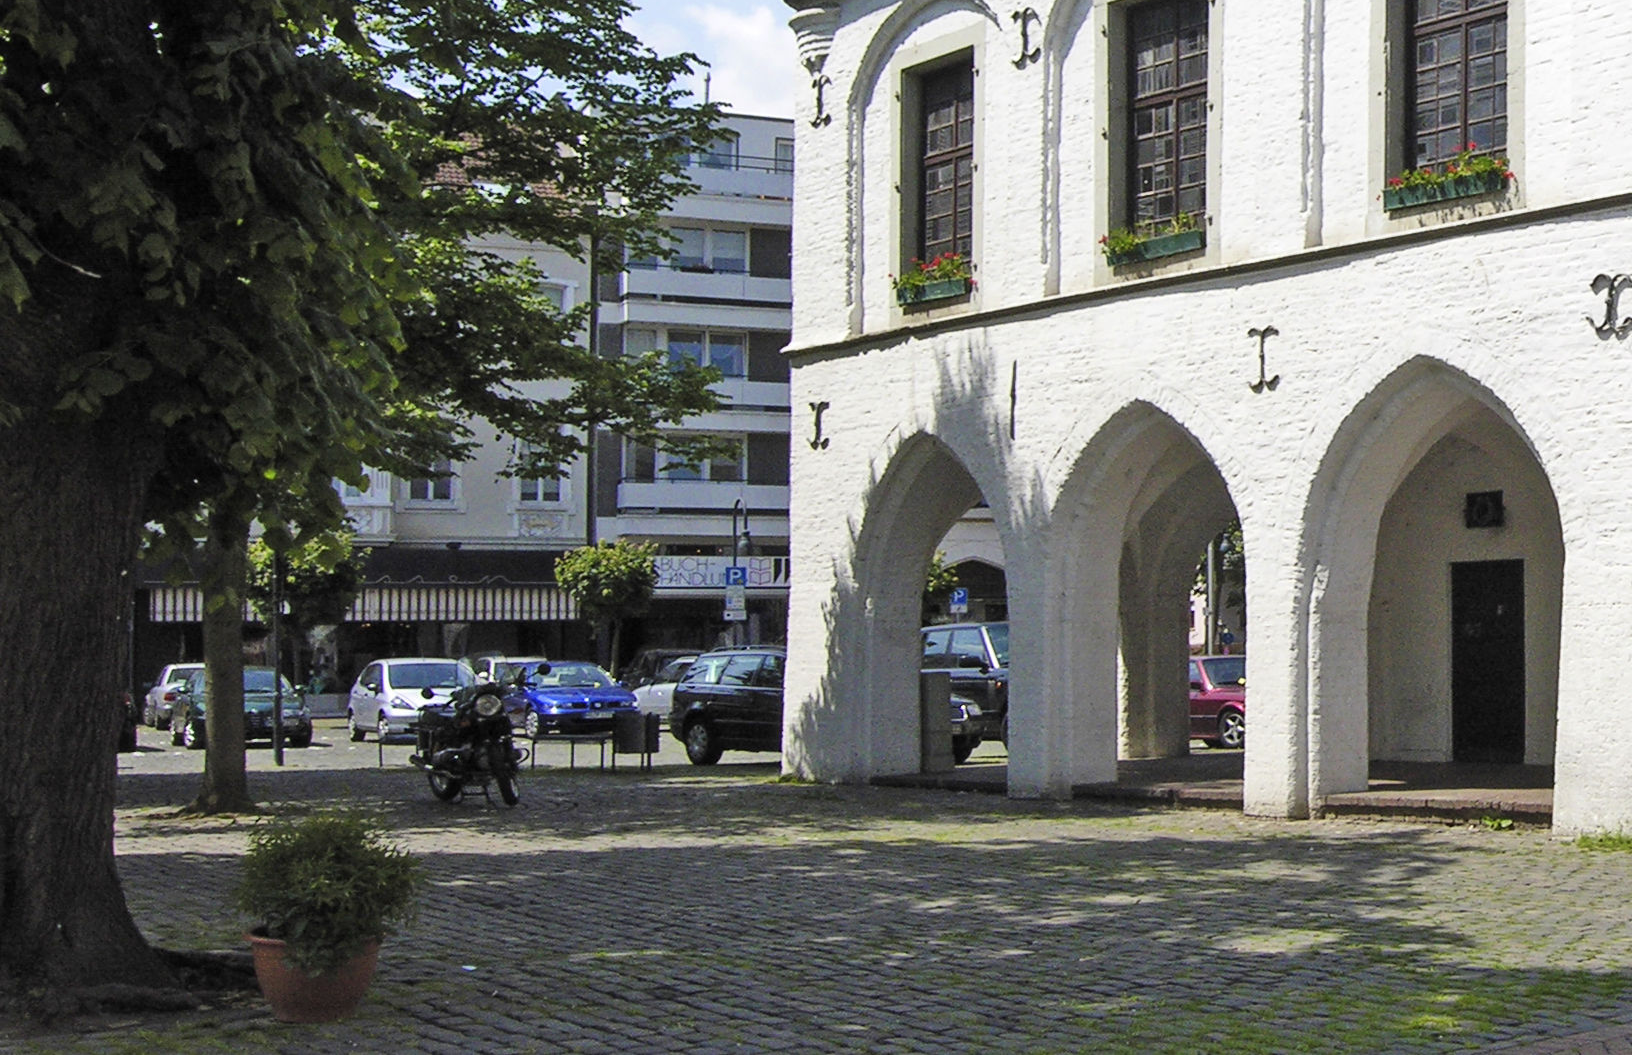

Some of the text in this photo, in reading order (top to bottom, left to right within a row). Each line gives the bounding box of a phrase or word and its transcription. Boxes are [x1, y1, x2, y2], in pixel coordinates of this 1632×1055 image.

[660, 557, 716, 572] BUCH-
[660, 572, 726, 586] HANDLU
[729, 569, 742, 583] P
